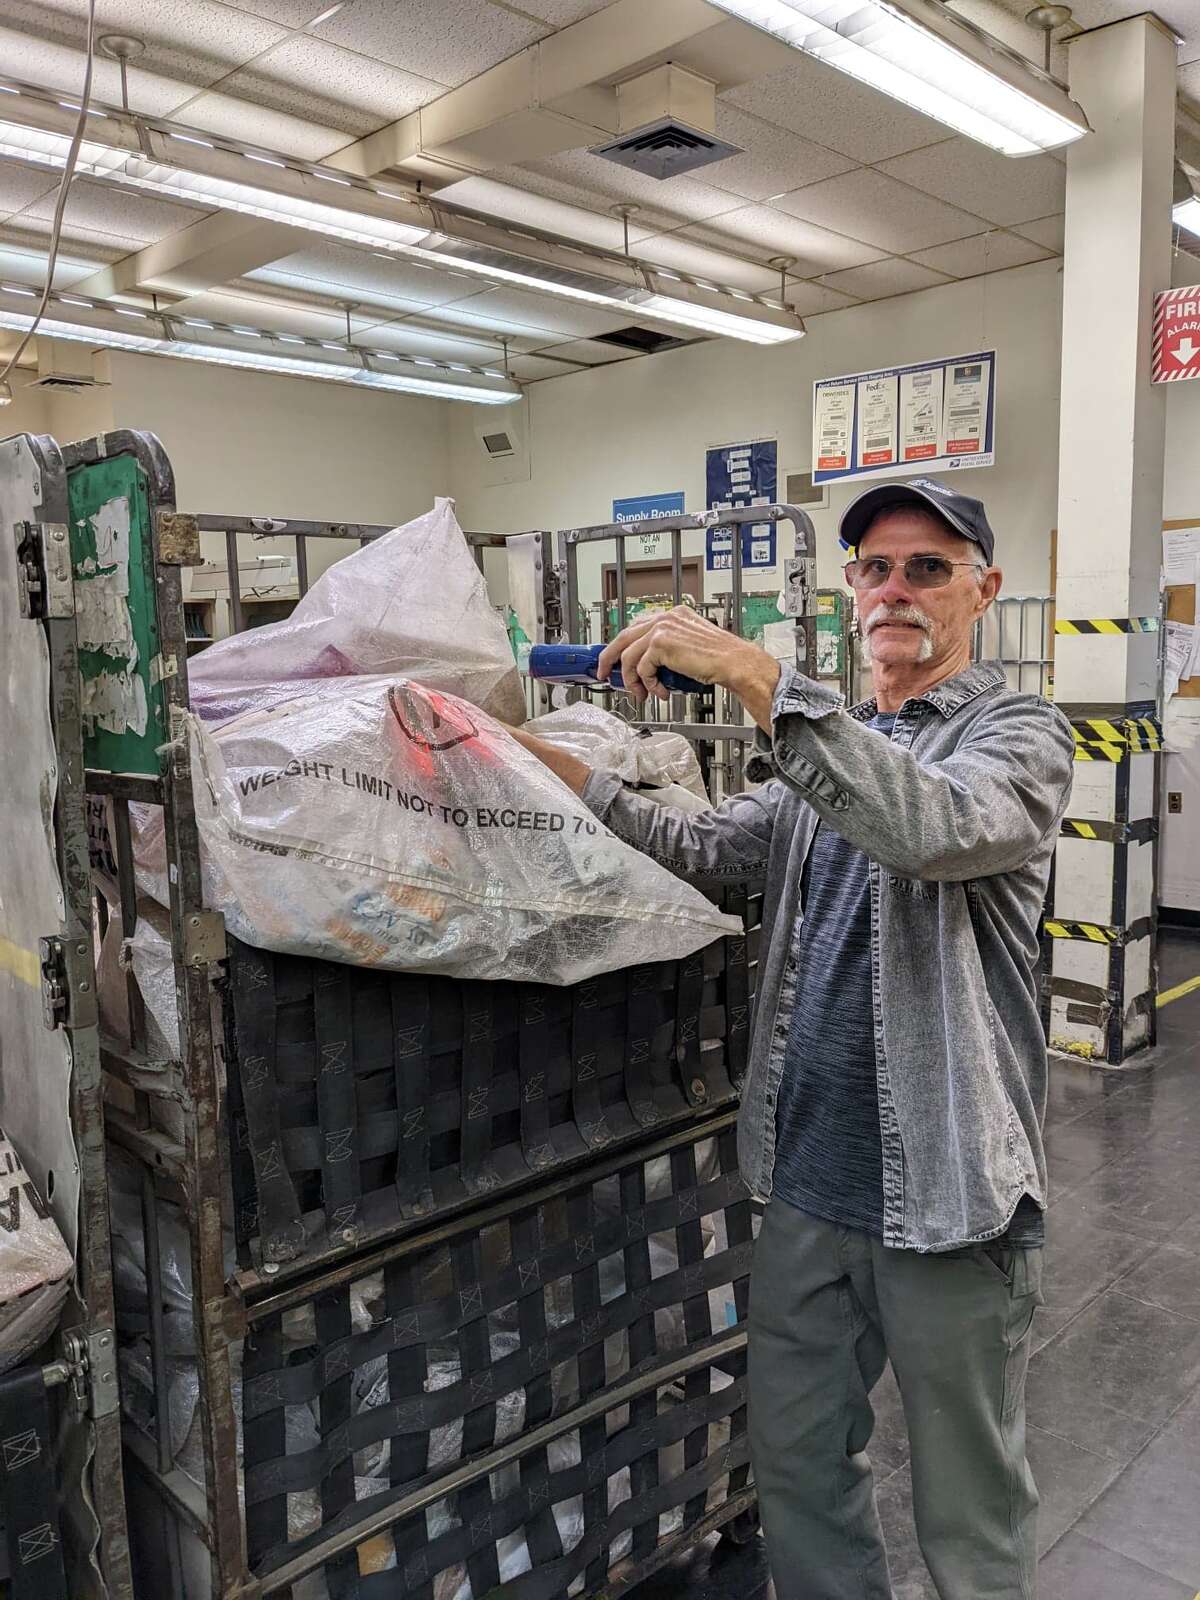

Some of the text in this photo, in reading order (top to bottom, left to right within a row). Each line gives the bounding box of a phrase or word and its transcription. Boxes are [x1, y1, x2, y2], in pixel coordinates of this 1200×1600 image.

[1165, 301, 1200, 320] FIR
[1167, 321, 1200, 338] ALAR
[640, 534, 660, 543] NOT AN
[644, 545, 656, 554] EXIT
[341, 767, 393, 801] LIMIT
[396, 788, 434, 817] NOT
[440, 805, 469, 828] TO
[476, 807, 566, 832] EXCEED
